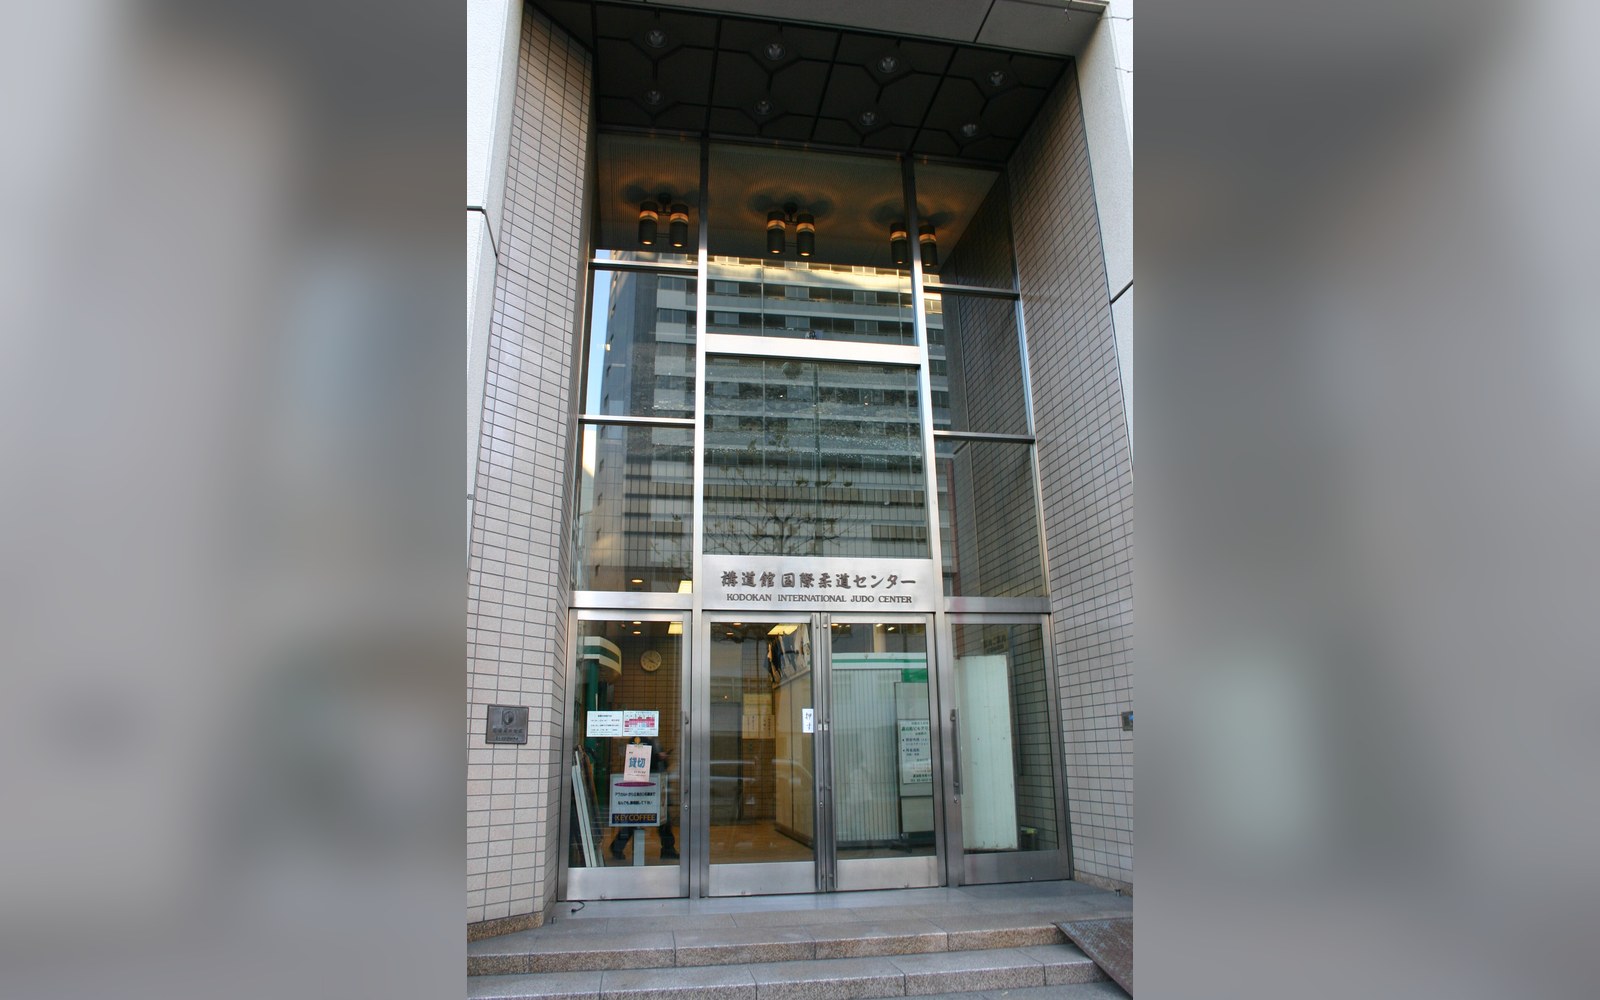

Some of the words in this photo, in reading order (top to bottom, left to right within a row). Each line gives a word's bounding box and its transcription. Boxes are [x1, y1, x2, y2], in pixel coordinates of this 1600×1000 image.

[726, 593, 772, 602] KODOKAN
[777, 594, 847, 602] INTERNATIONAL
[850, 595, 875, 603] JUDO
[878, 595, 912, 603] CENTER
[629, 757, 646, 768] 貸切
